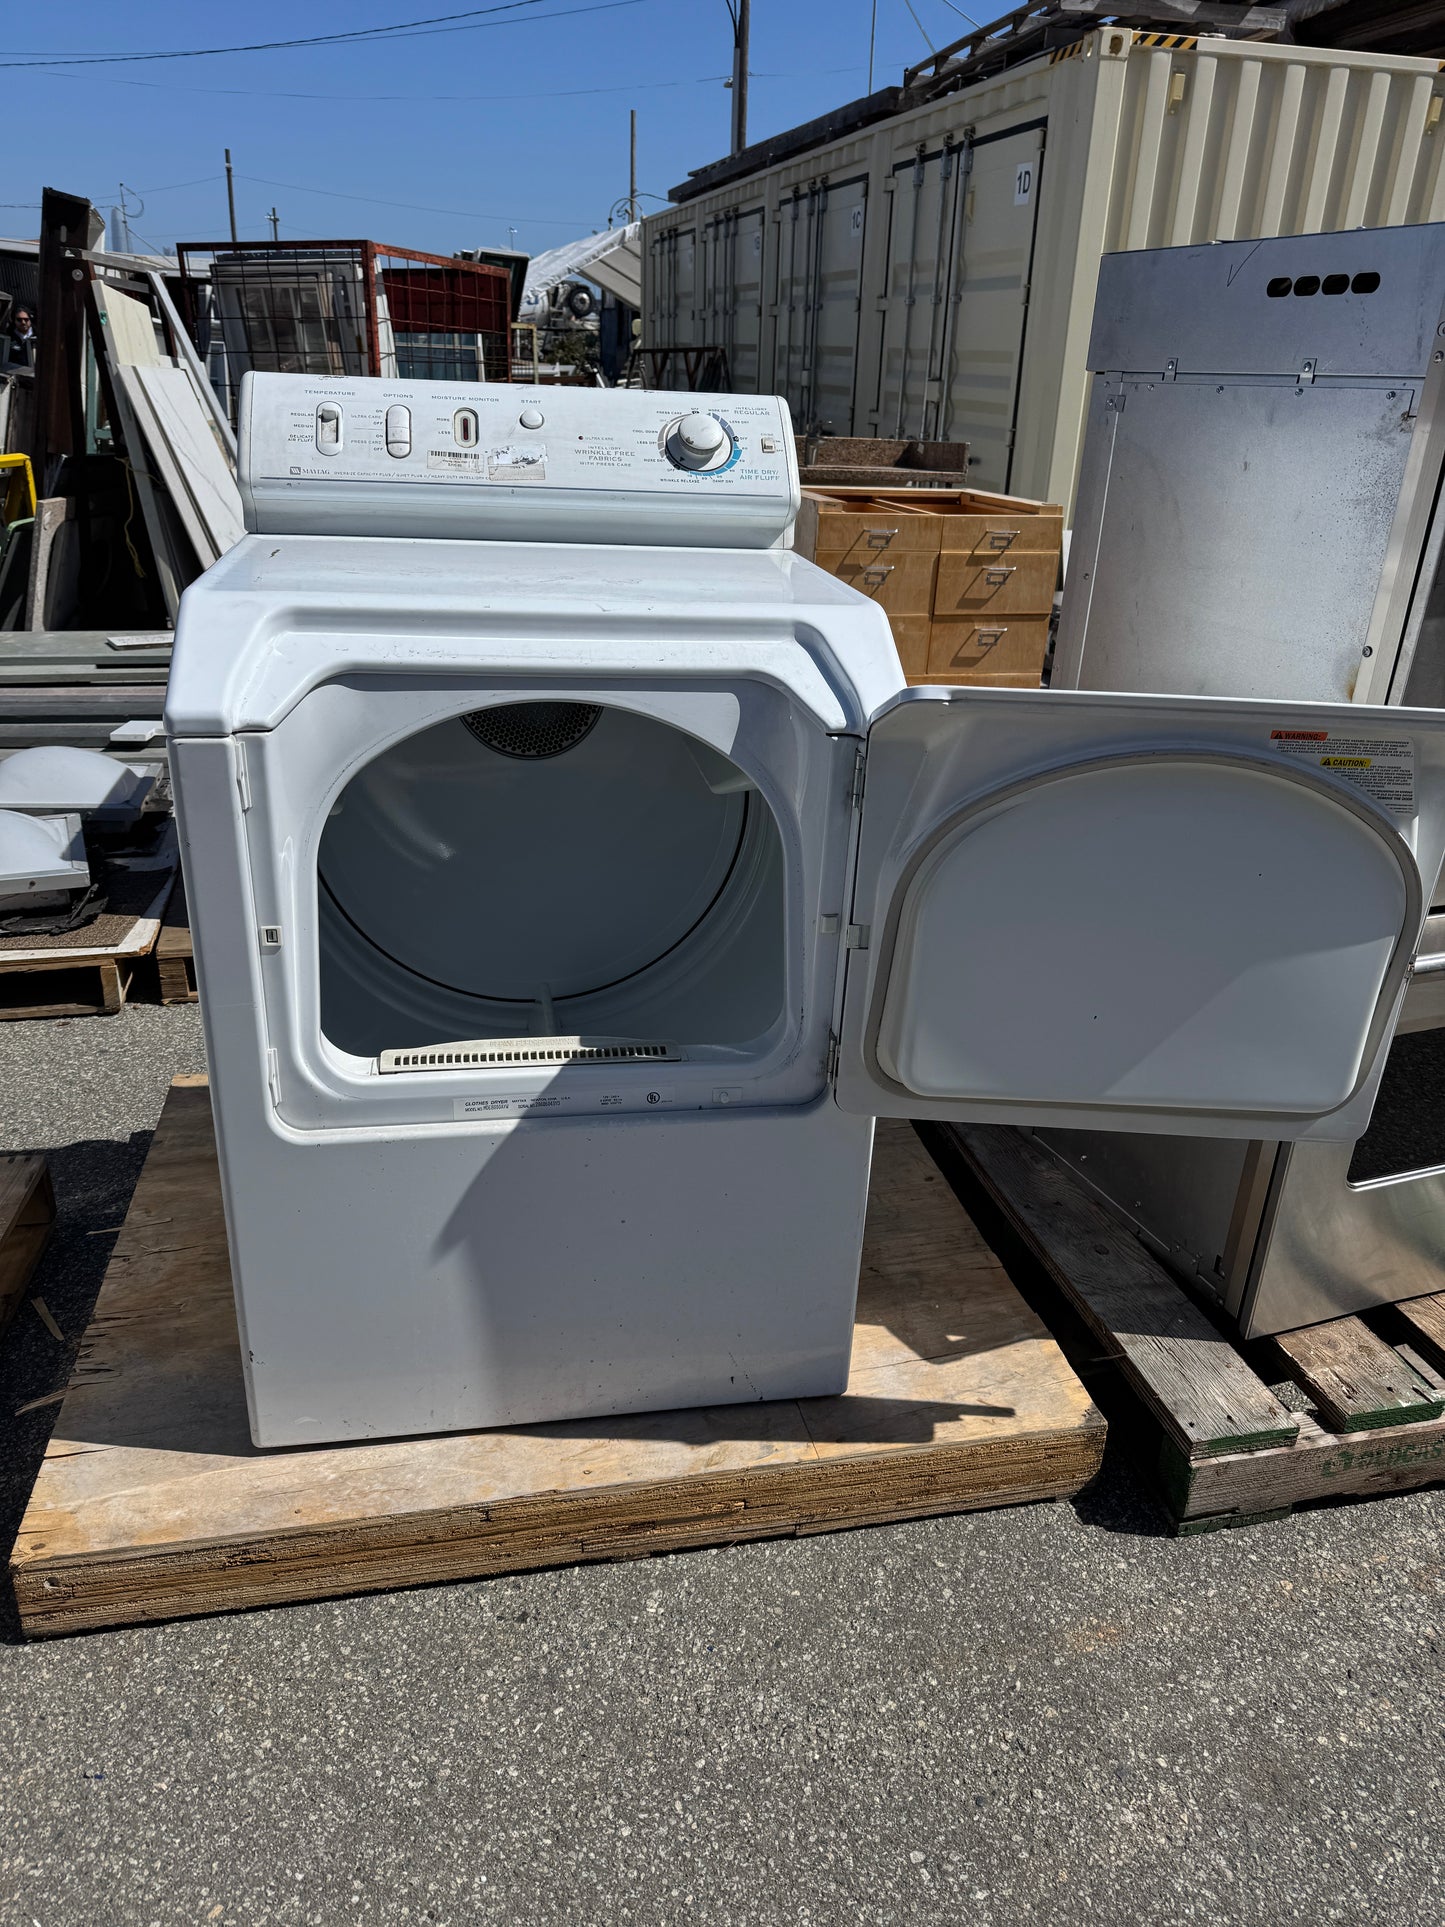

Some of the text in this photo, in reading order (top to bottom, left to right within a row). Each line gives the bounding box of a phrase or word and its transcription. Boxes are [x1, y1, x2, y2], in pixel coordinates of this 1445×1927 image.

[1017, 170, 1031, 194] 1D
[852, 210, 861, 230] 1C
[1285, 732, 1322, 740] WARNING:
[1332, 759, 1367, 767] CAUTION:
